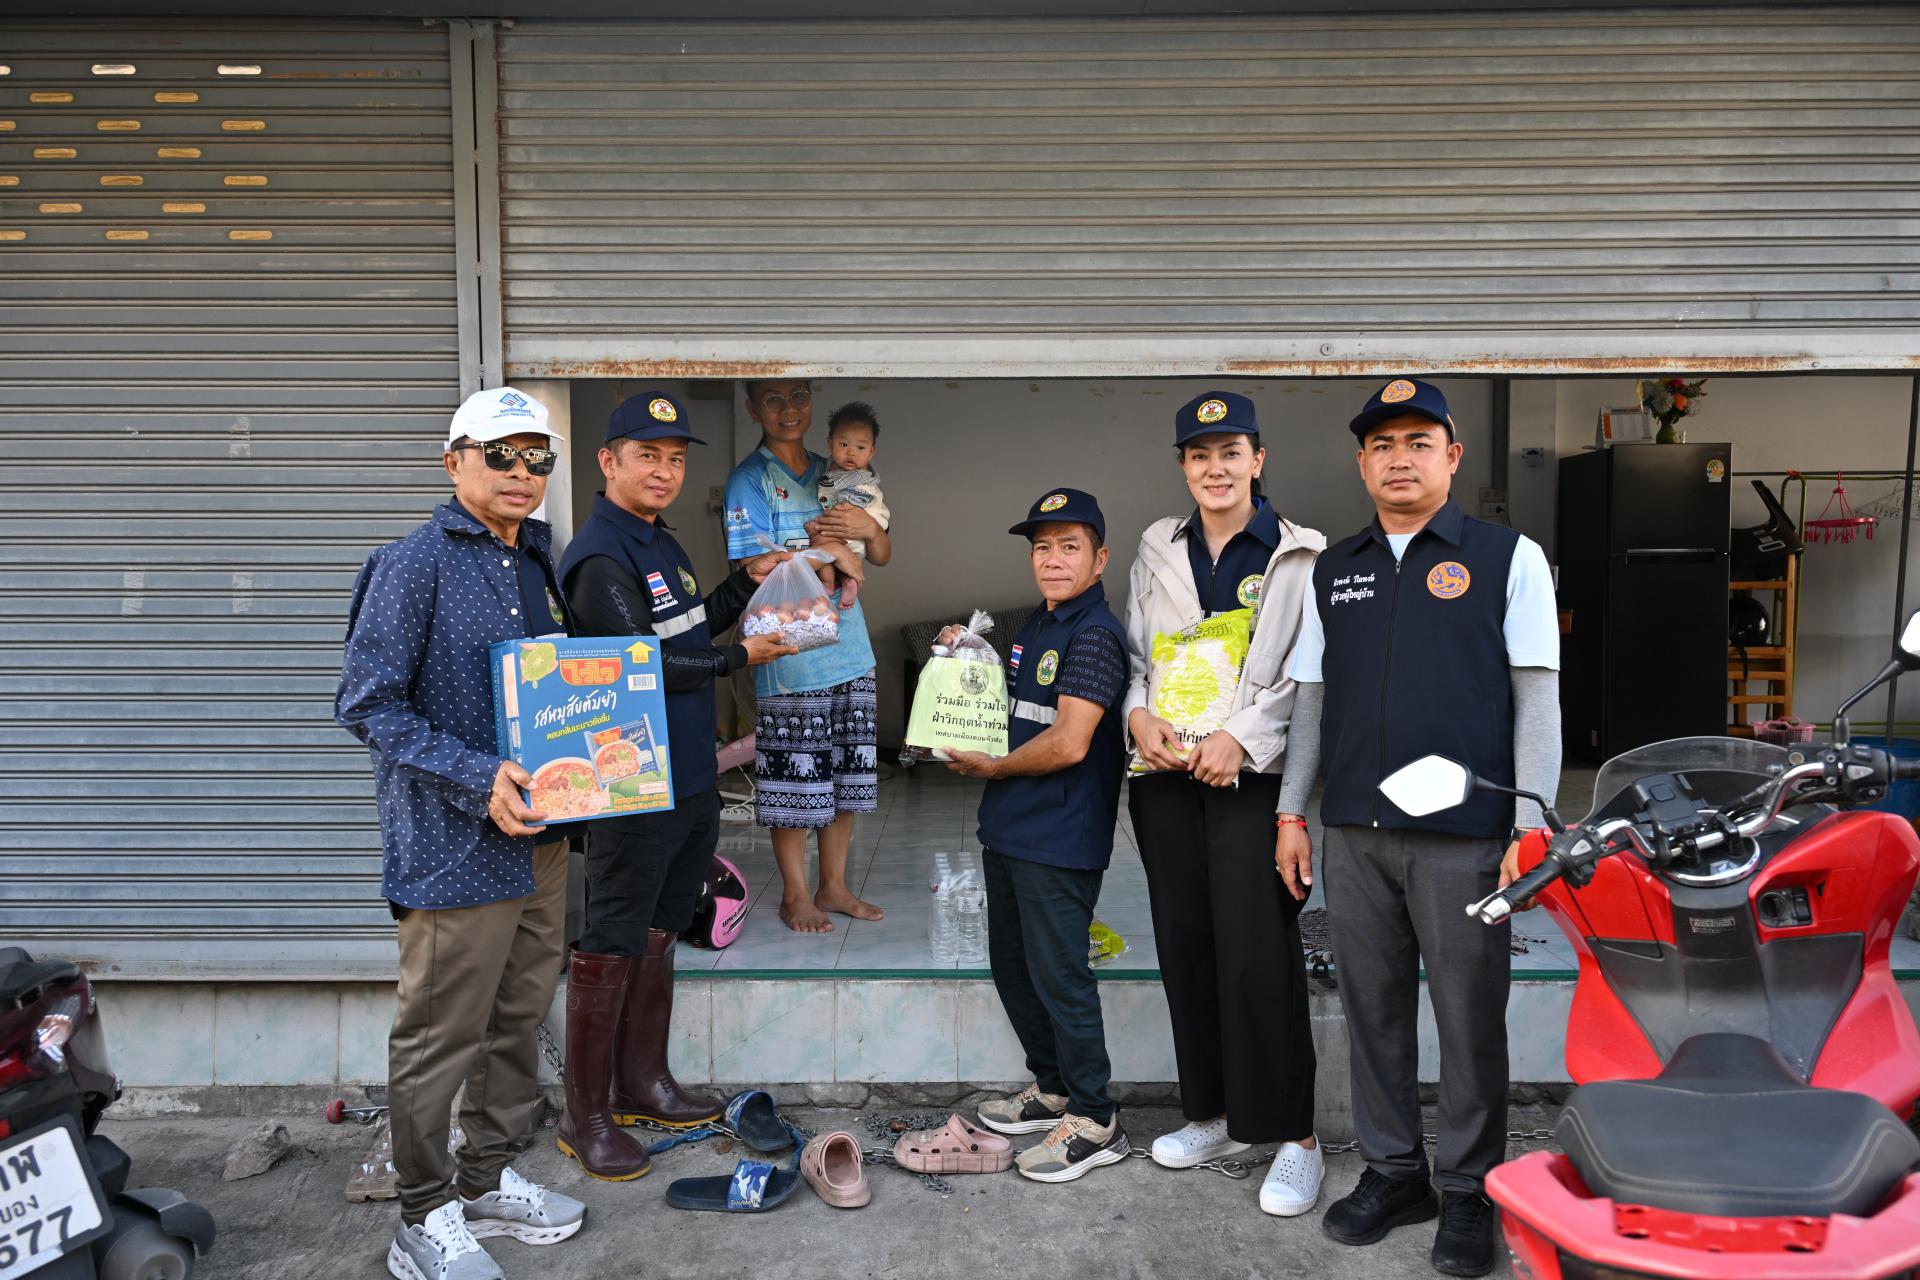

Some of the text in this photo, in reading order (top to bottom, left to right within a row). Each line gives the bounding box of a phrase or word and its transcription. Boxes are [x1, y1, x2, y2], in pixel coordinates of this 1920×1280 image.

[533, 689, 617, 729] รสหมูสับต้มยำ
[936, 693, 1007, 712] ร่วมมือ ร่วมใจ
[932, 711, 1009, 731] ฝ่าวิกฤตน้ำท่วม
